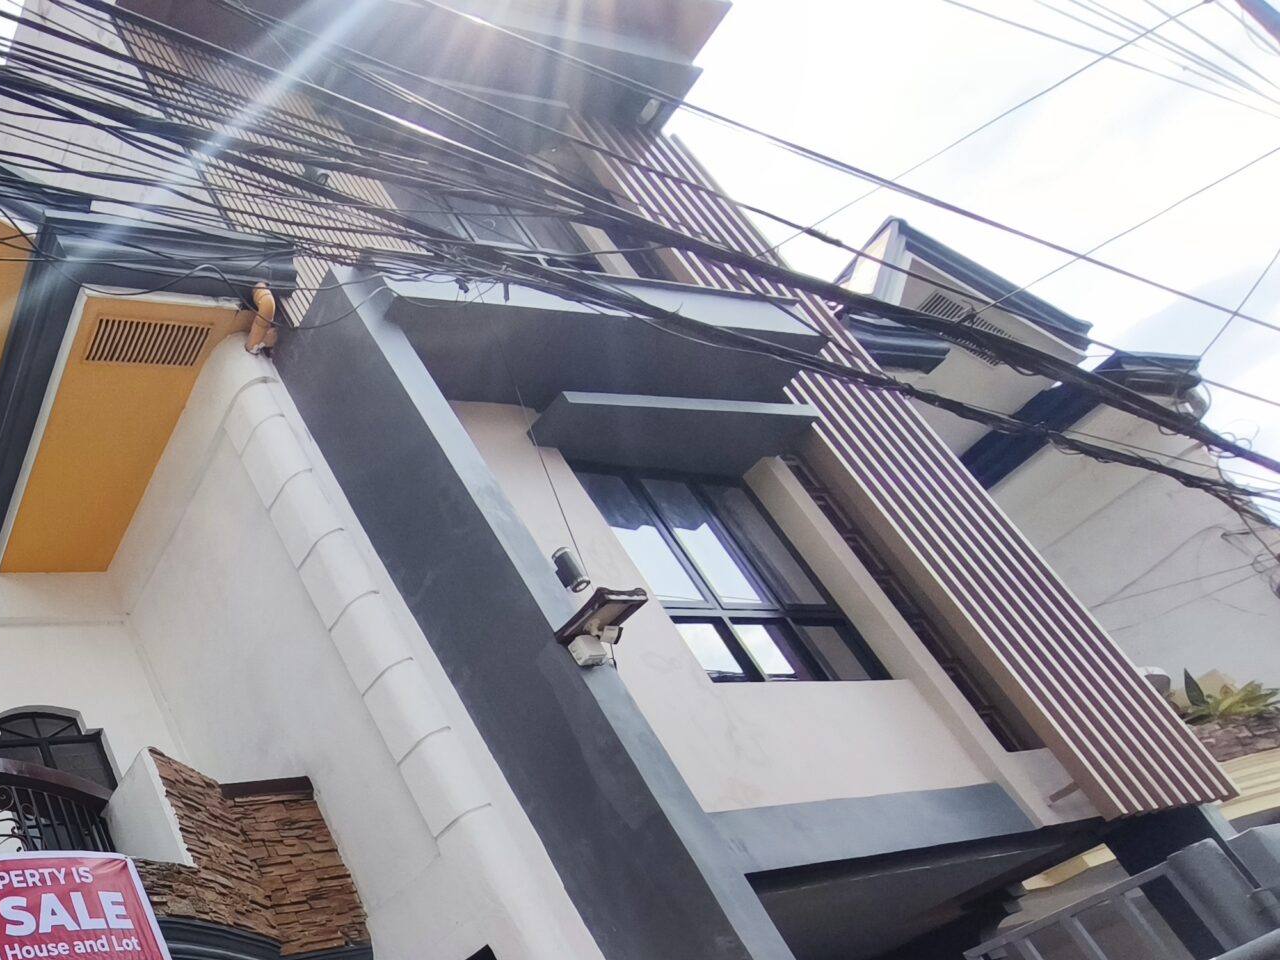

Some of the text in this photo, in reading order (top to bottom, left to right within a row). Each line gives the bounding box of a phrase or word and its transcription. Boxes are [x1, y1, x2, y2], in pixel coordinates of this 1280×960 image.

[71, 866, 94, 884] IS
[74, 935, 110, 954] and
[111, 934, 141, 952] Lot
